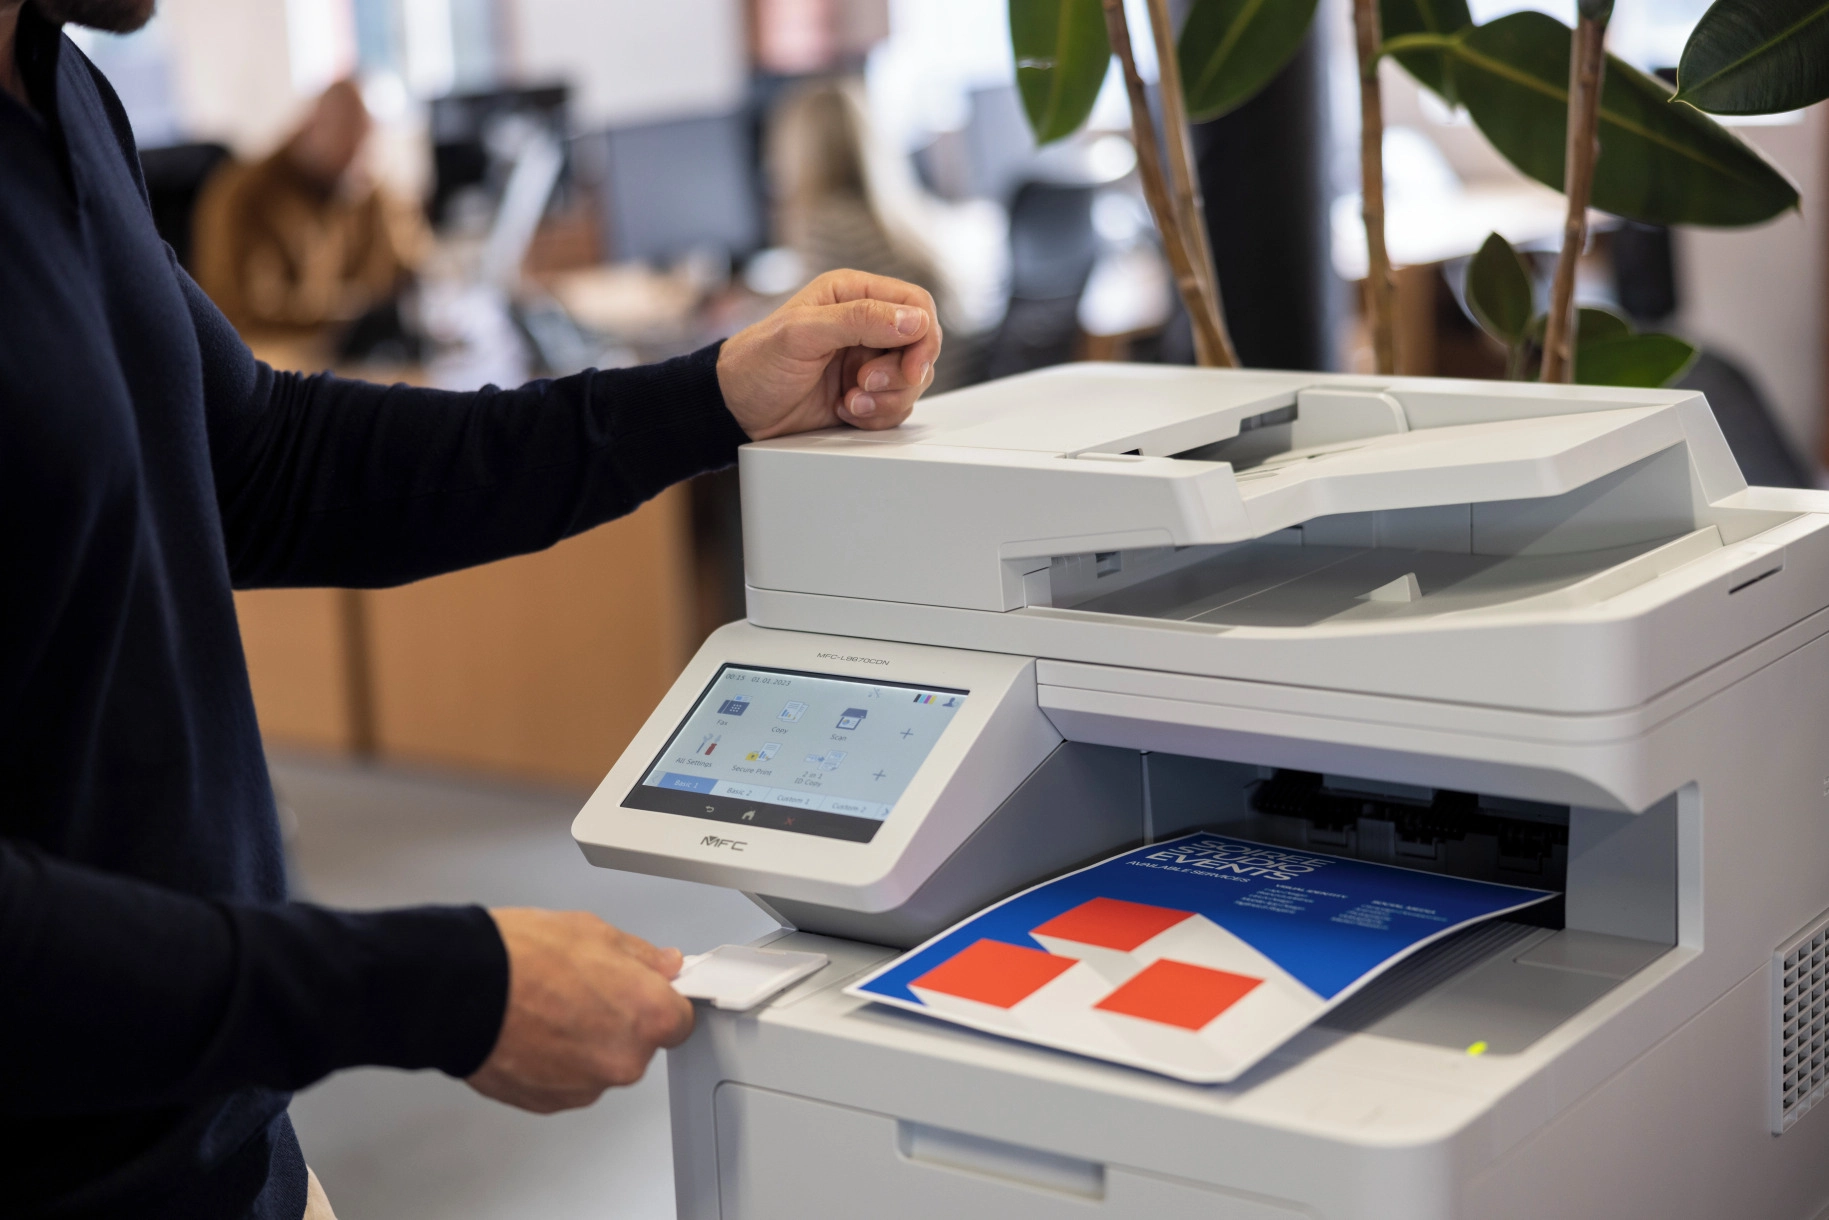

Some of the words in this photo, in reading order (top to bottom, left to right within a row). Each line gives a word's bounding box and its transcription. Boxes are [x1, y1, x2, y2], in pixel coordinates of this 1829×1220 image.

[725, 673, 745, 681] 00:15
[751, 676, 792, 687] 01.01.2023
[771, 726, 788, 734] Copy
[830, 733, 847, 741] Scan
[687, 758, 712, 768] Settings
[731, 764, 754, 774] Secure
[755, 768, 772, 776] Print
[674, 779, 691, 788] Basic
[804, 778, 822, 787] Copy
[726, 787, 744, 796] Basic
[777, 794, 803, 804] Custom
[832, 802, 859, 811] Custom
[700, 835, 748, 851] MFC
[1192, 840, 1337, 868] SOIREE
[1168, 846, 1315, 873] STUDIO
[1145, 851, 1300, 881] EVENTS
[1125, 860, 1190, 874] AVAILABLE
[1190, 868, 1252, 883] SERVICES
